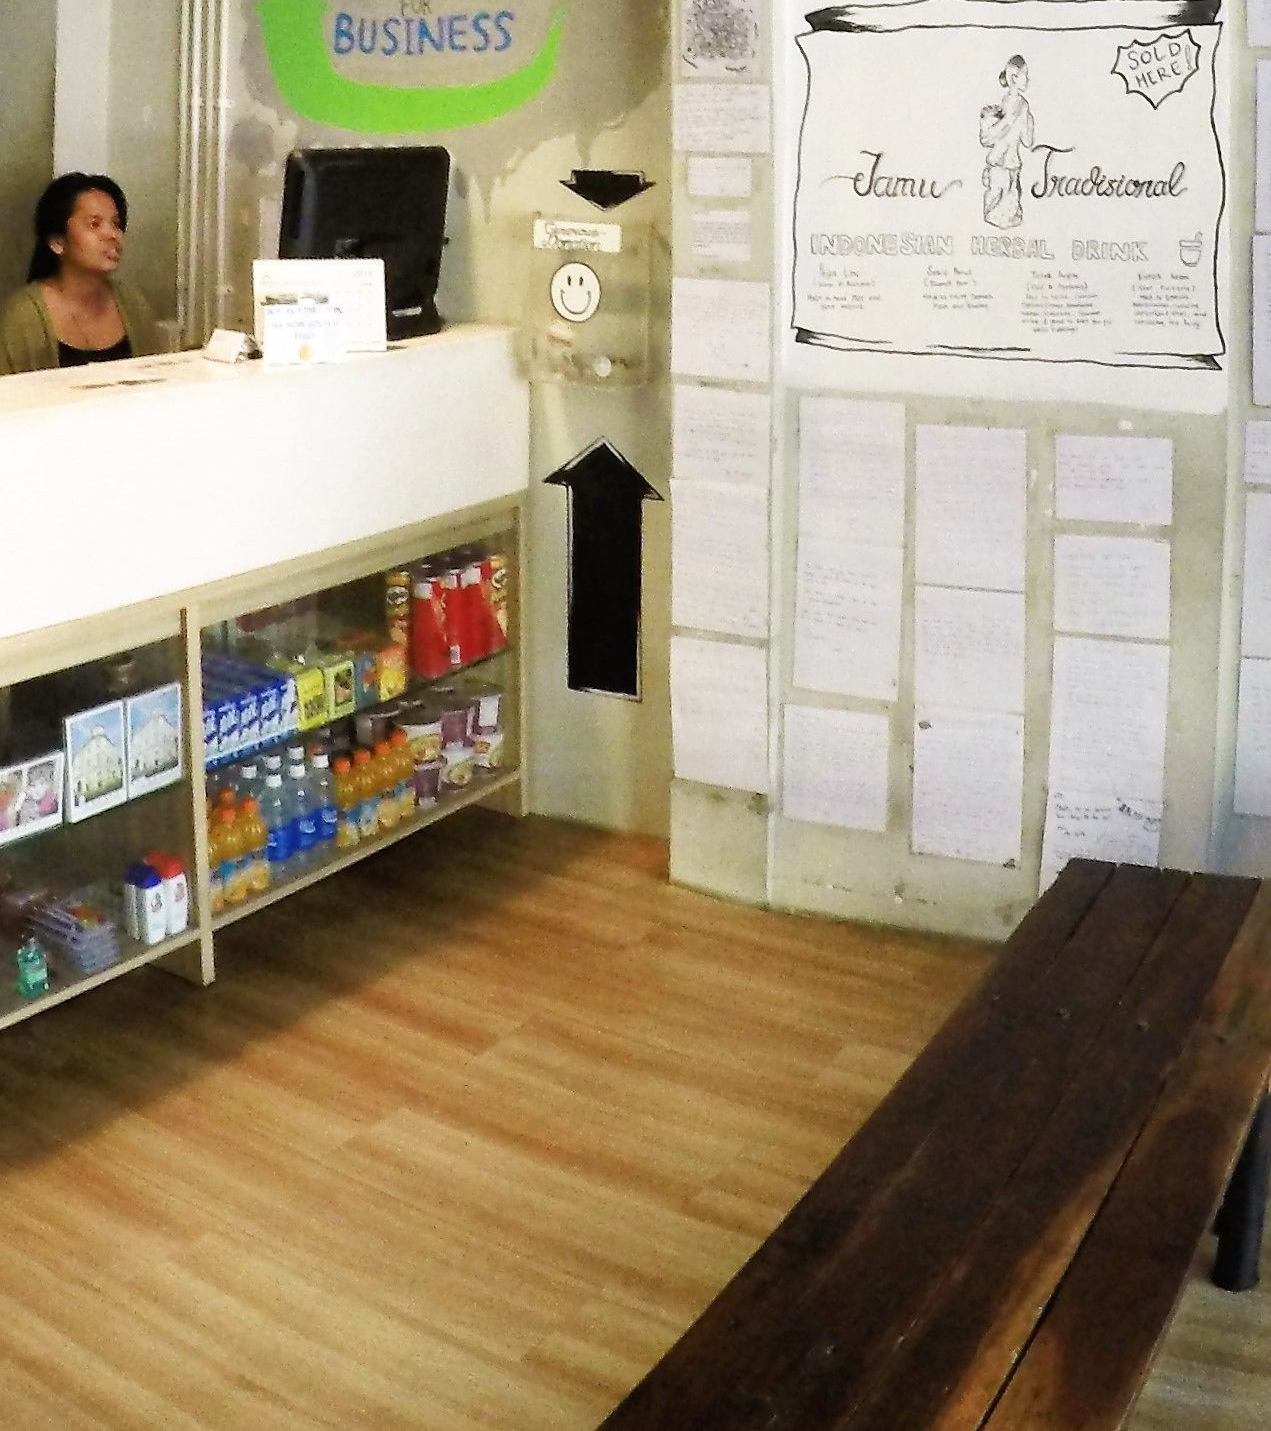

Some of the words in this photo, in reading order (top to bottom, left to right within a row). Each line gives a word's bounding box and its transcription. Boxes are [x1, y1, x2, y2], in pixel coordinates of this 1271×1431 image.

[333, 10, 515, 56] BUSINESS
[1128, 41, 1182, 71] SOLD
[829, 149, 961, 198] Jamu
[1030, 144, 1188, 199] Tradisional
[809, 232, 954, 257] INDONESIAN
[971, 234, 1055, 262] HERBAL
[1071, 239, 1150, 262] DRINK
